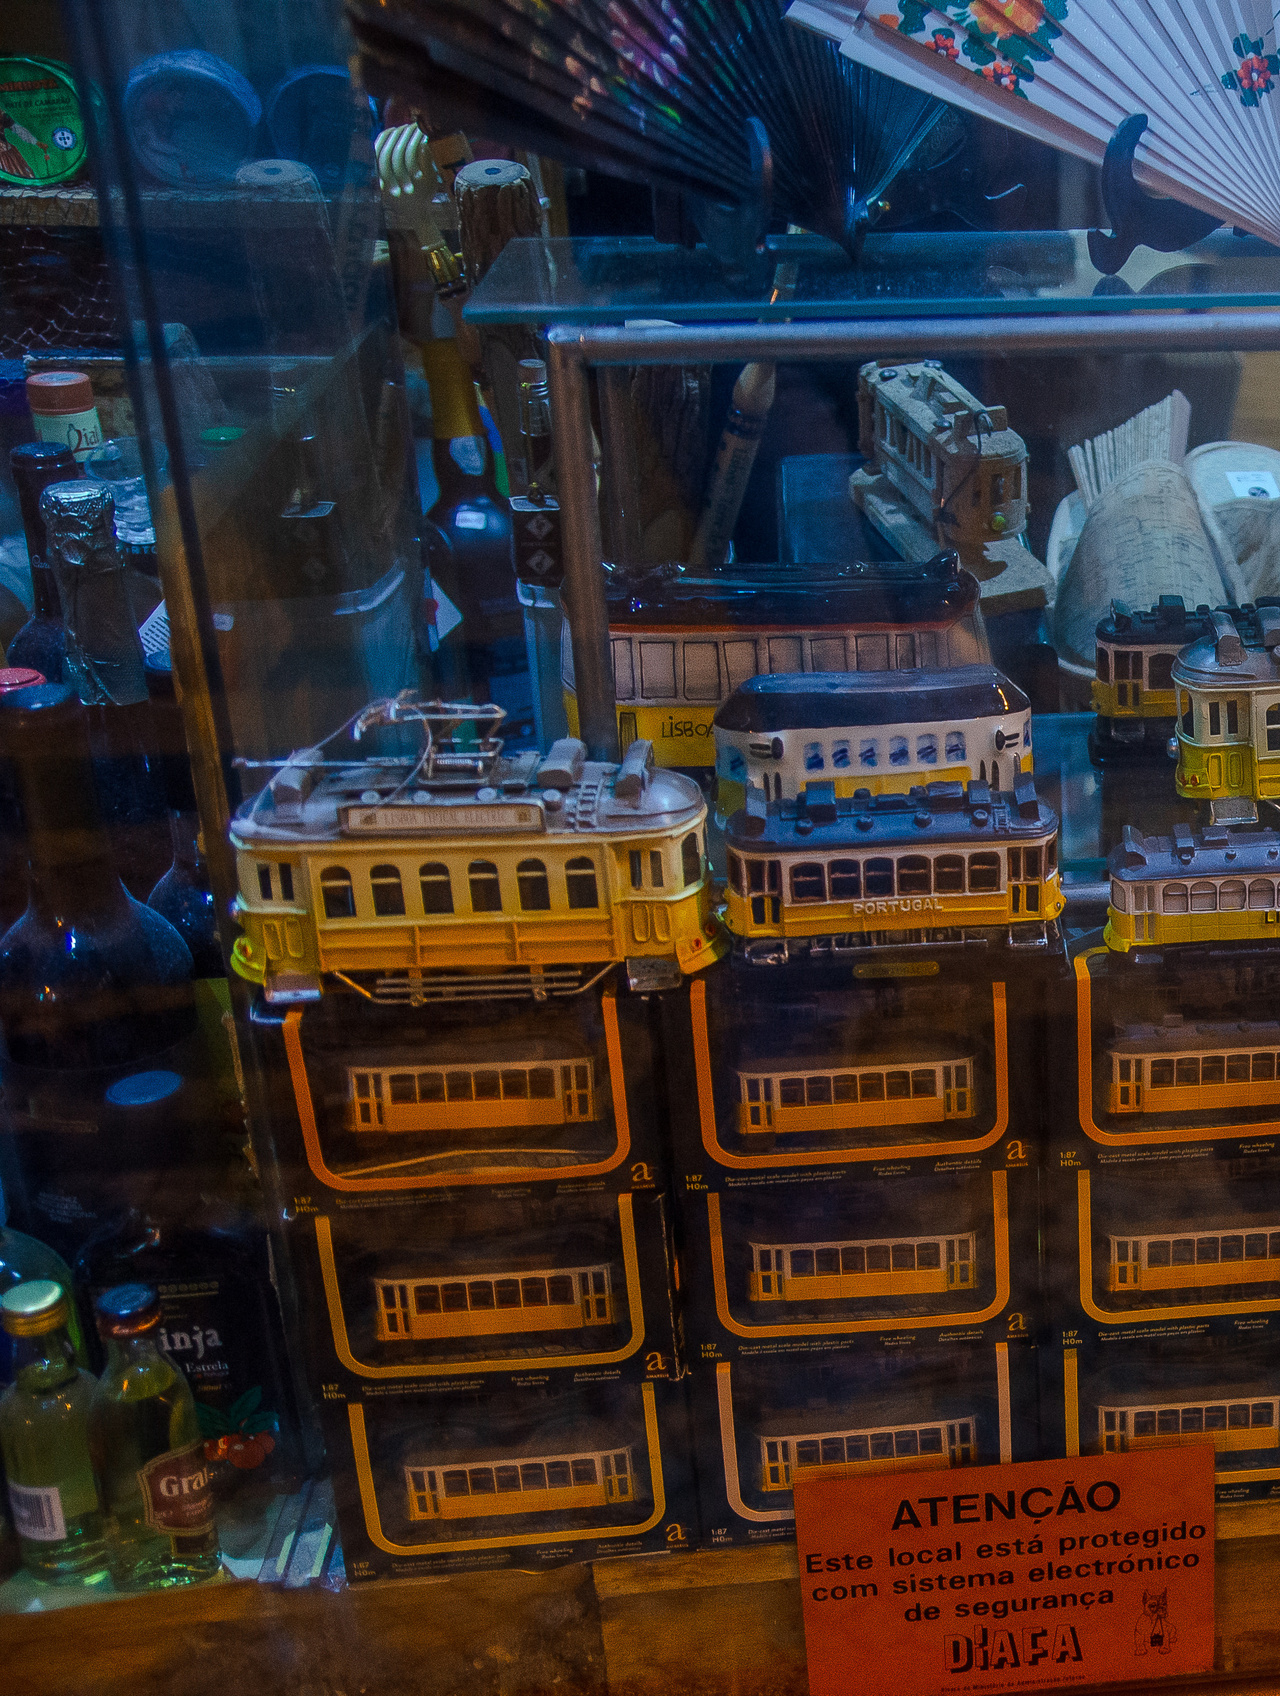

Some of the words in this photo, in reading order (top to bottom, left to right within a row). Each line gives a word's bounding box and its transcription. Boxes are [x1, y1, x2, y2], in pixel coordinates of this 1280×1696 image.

[853, 898, 944, 916] PORTUGAL
[1006, 1140, 1027, 1160] a
[1060, 1151, 1076, 1159] 1:87
[1008, 1312, 1027, 1332] a
[159, 1325, 223, 1359] inja
[700, 1343, 717, 1351] 1:87
[645, 1351, 666, 1372] a
[322, 1384, 339, 1392] 1:87
[890, 1480, 1121, 1532] ATENÇÃO
[711, 1528, 727, 1536] 1:87
[806, 1552, 874, 1574] Este
[888, 1541, 962, 1567] local
[976, 1534, 1044, 1560] está
[1058, 1520, 1207, 1556] protegido
[811, 1582, 879, 1602] com
[892, 1568, 1014, 1596] sistema
[1028, 1551, 1200, 1583] electrónico
[904, 1602, 940, 1622] de
[954, 1588, 1114, 1618] segurança
